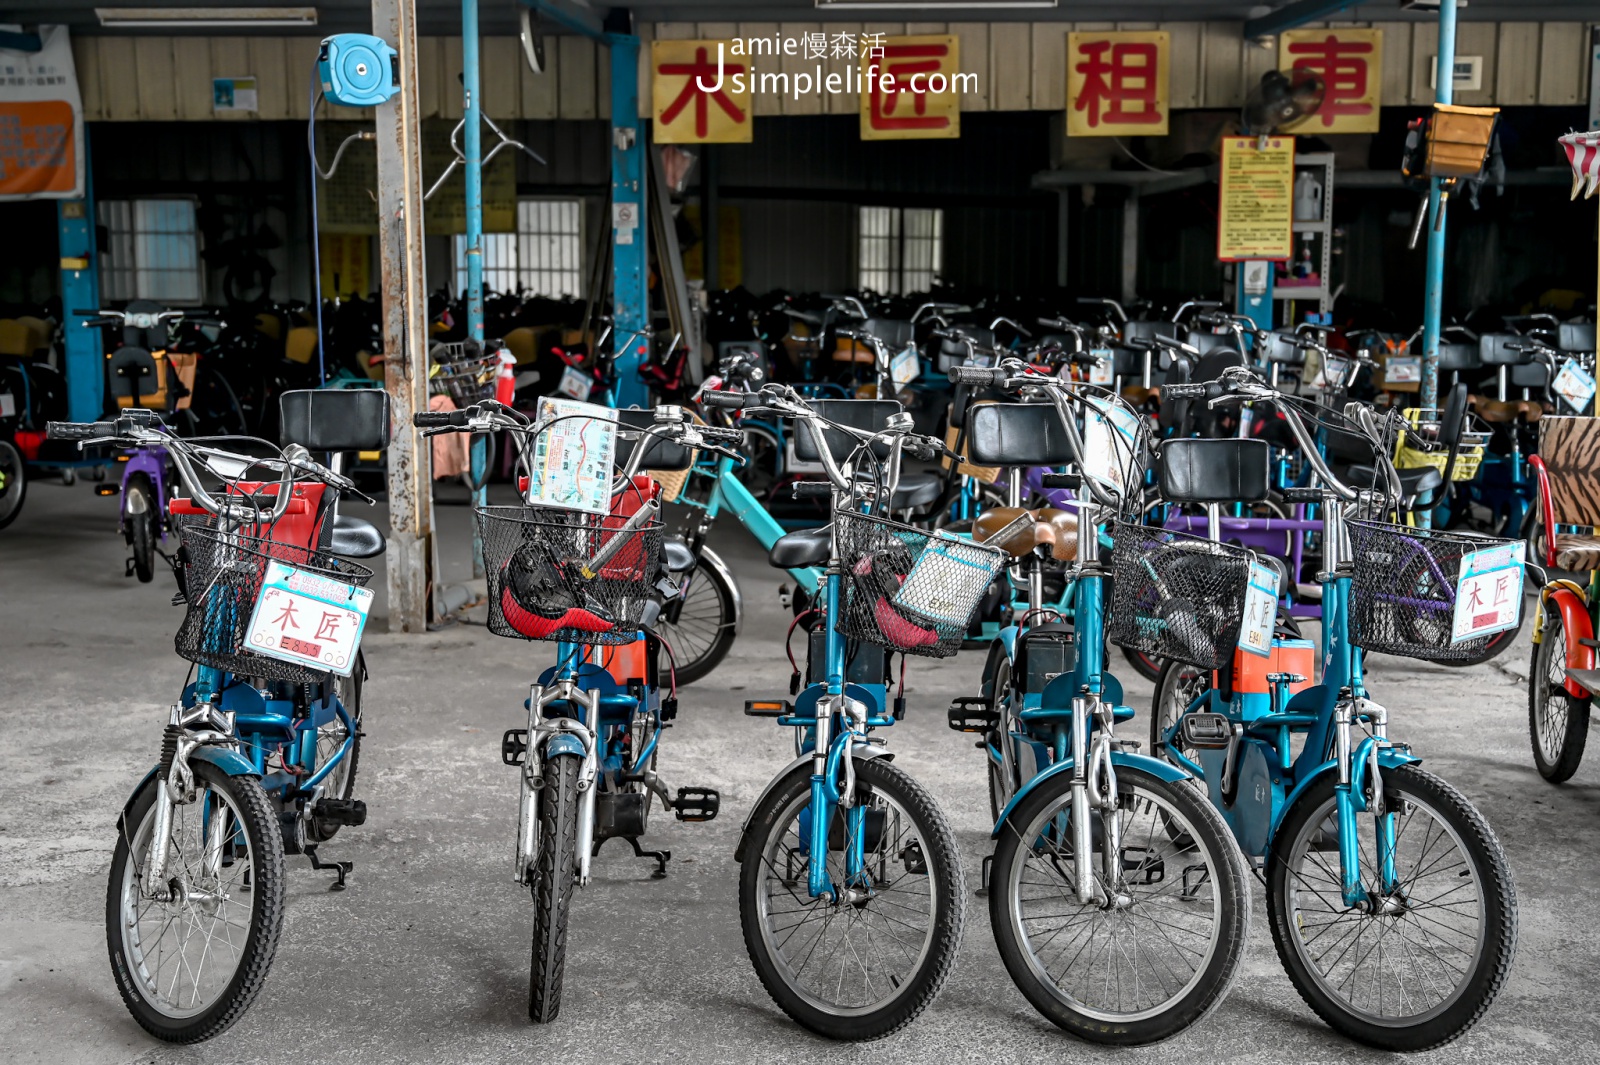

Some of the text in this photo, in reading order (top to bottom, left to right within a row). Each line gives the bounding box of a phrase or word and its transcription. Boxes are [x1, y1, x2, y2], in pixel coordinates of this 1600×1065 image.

[658, 34, 1375, 137] 木 匠 租 車
[281, 636, 318, 658] E855
